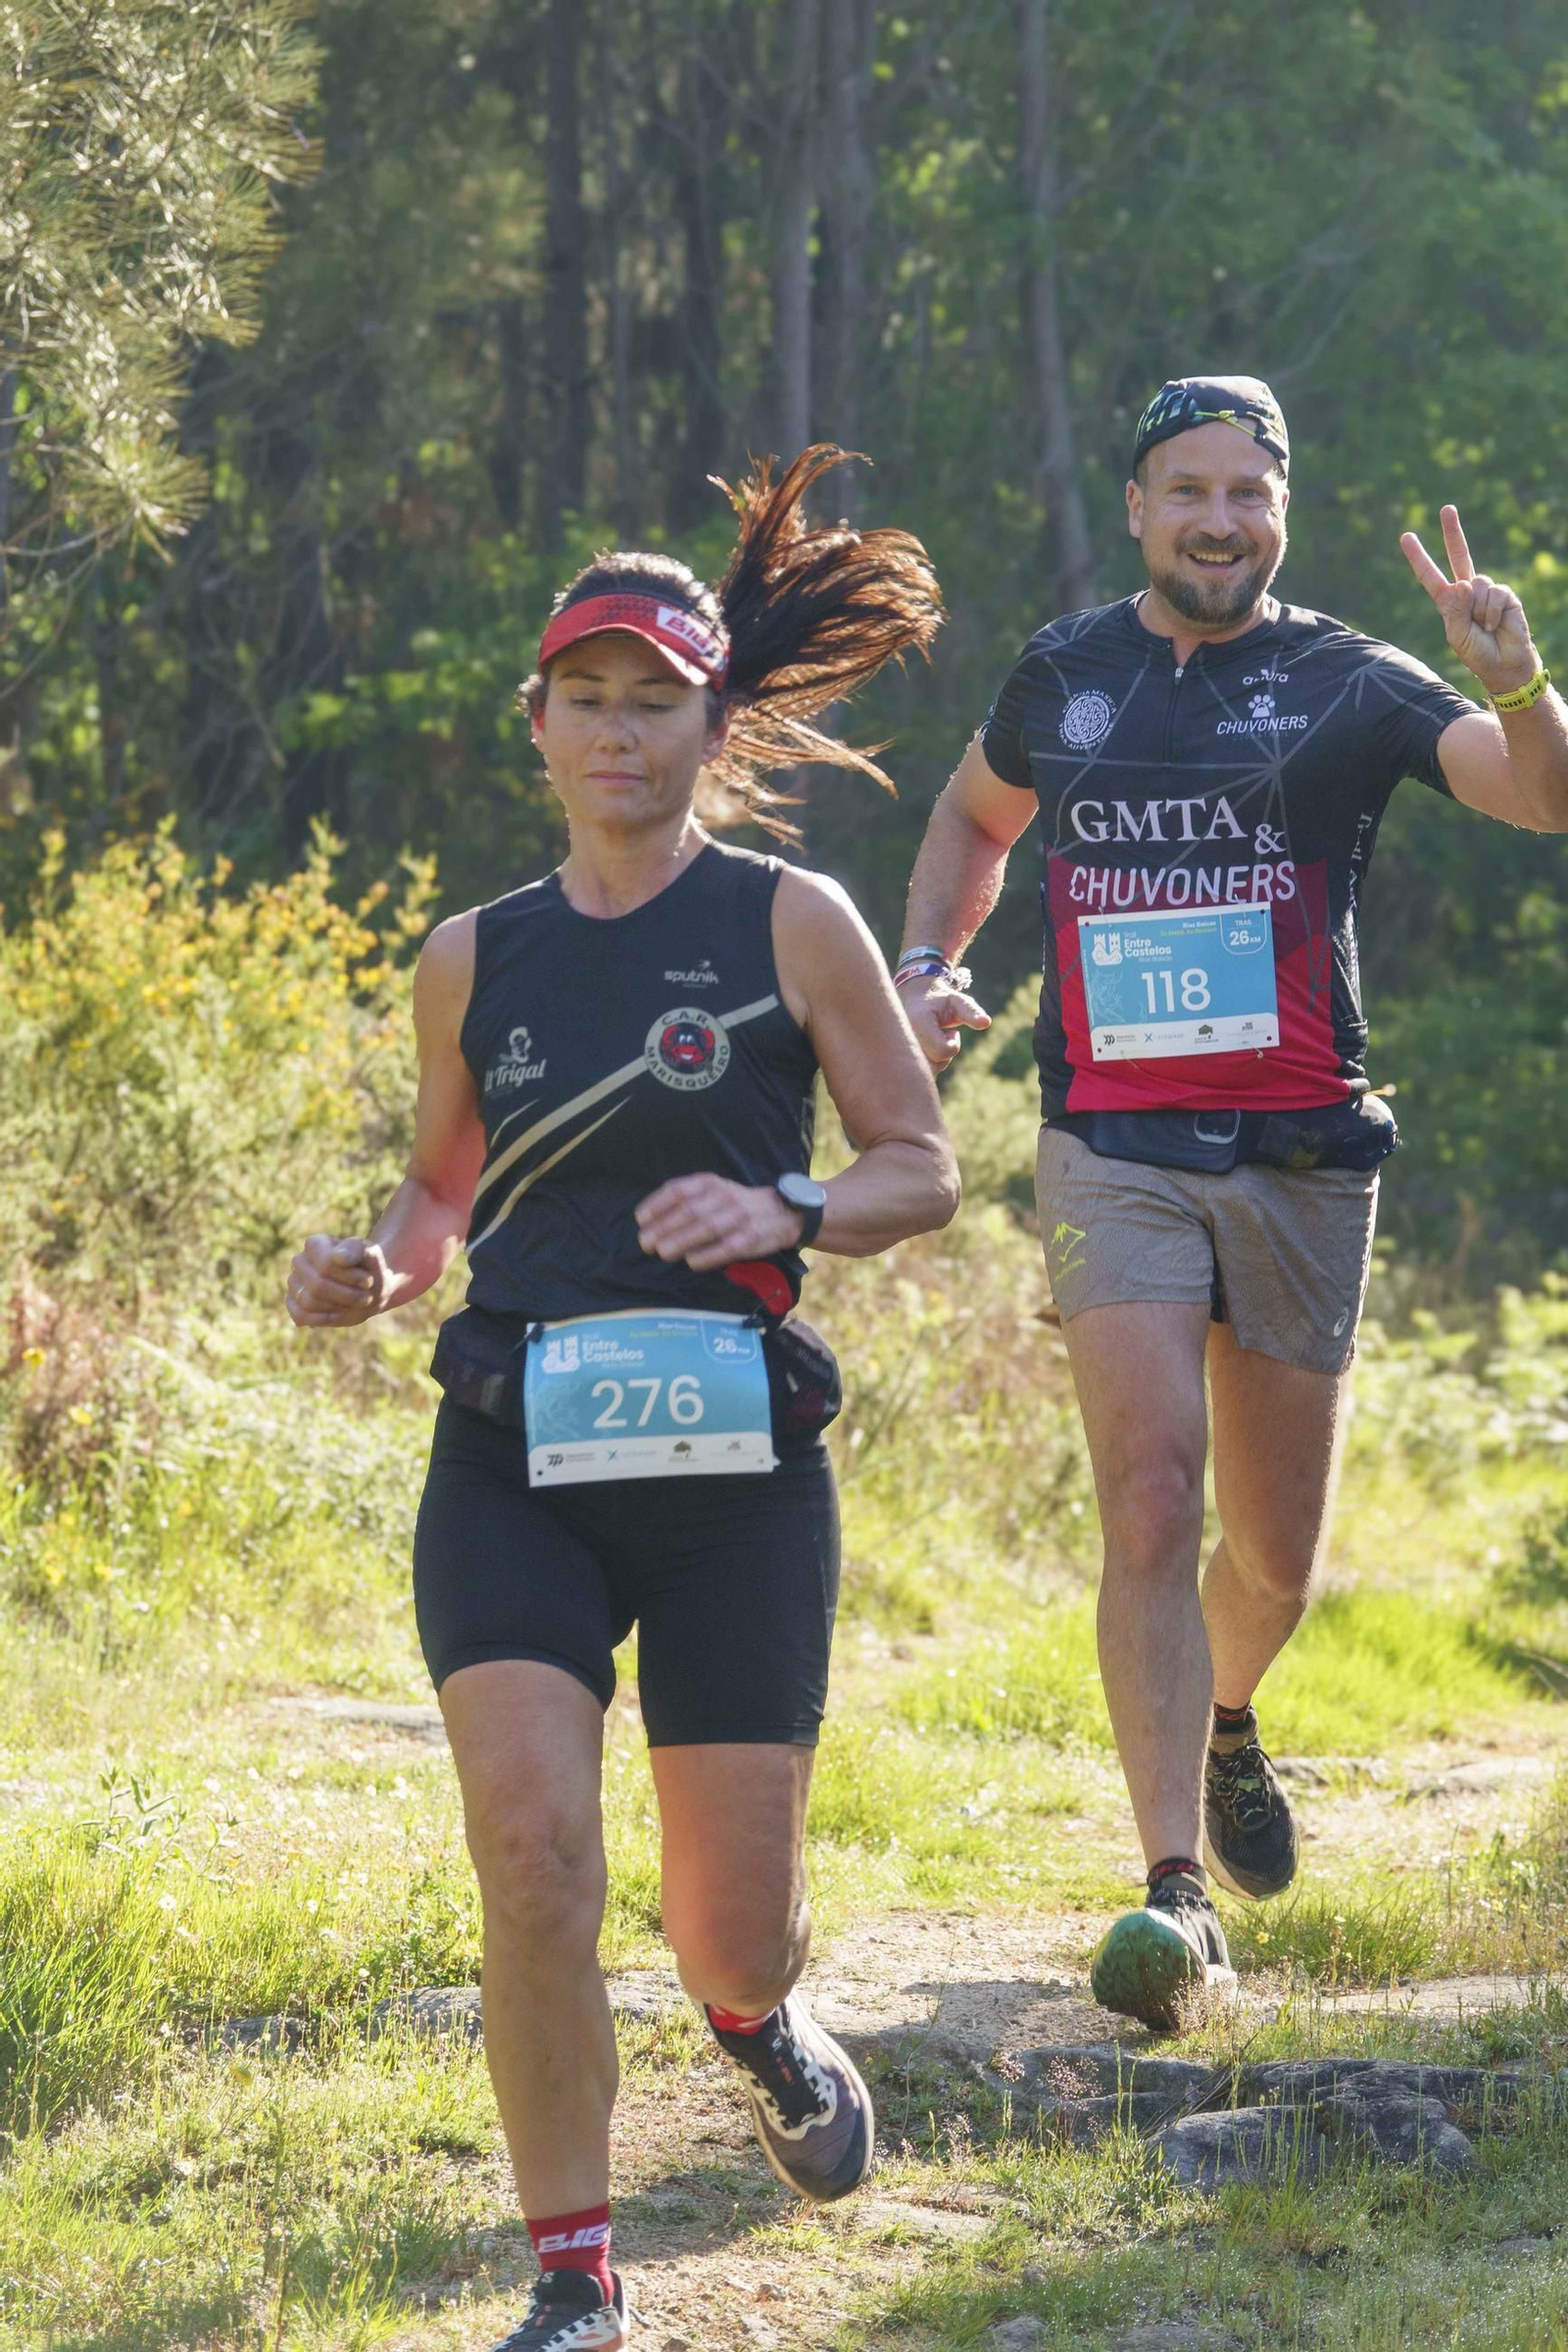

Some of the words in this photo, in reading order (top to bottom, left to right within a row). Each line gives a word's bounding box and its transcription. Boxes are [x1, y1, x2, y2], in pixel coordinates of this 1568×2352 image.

[1216, 714, 1308, 735] CHUVONERS
[1070, 796, 1249, 843] GMTA
[1254, 823, 1287, 855] &
[1069, 860, 1296, 906] CHUVONERS
[1124, 938, 1152, 949] Entre
[1124, 946, 1172, 957] Castelos
[1230, 930, 1250, 946] 26
[1142, 968, 1211, 1014] 118
[494, 1058, 547, 1088] Trigal
[645, 1045, 729, 1089] MARISQUEIRO
[583, 1348, 645, 1363] Castelos
[591, 1374, 705, 1429] 276
[539, 2222, 609, 2253] BIG
